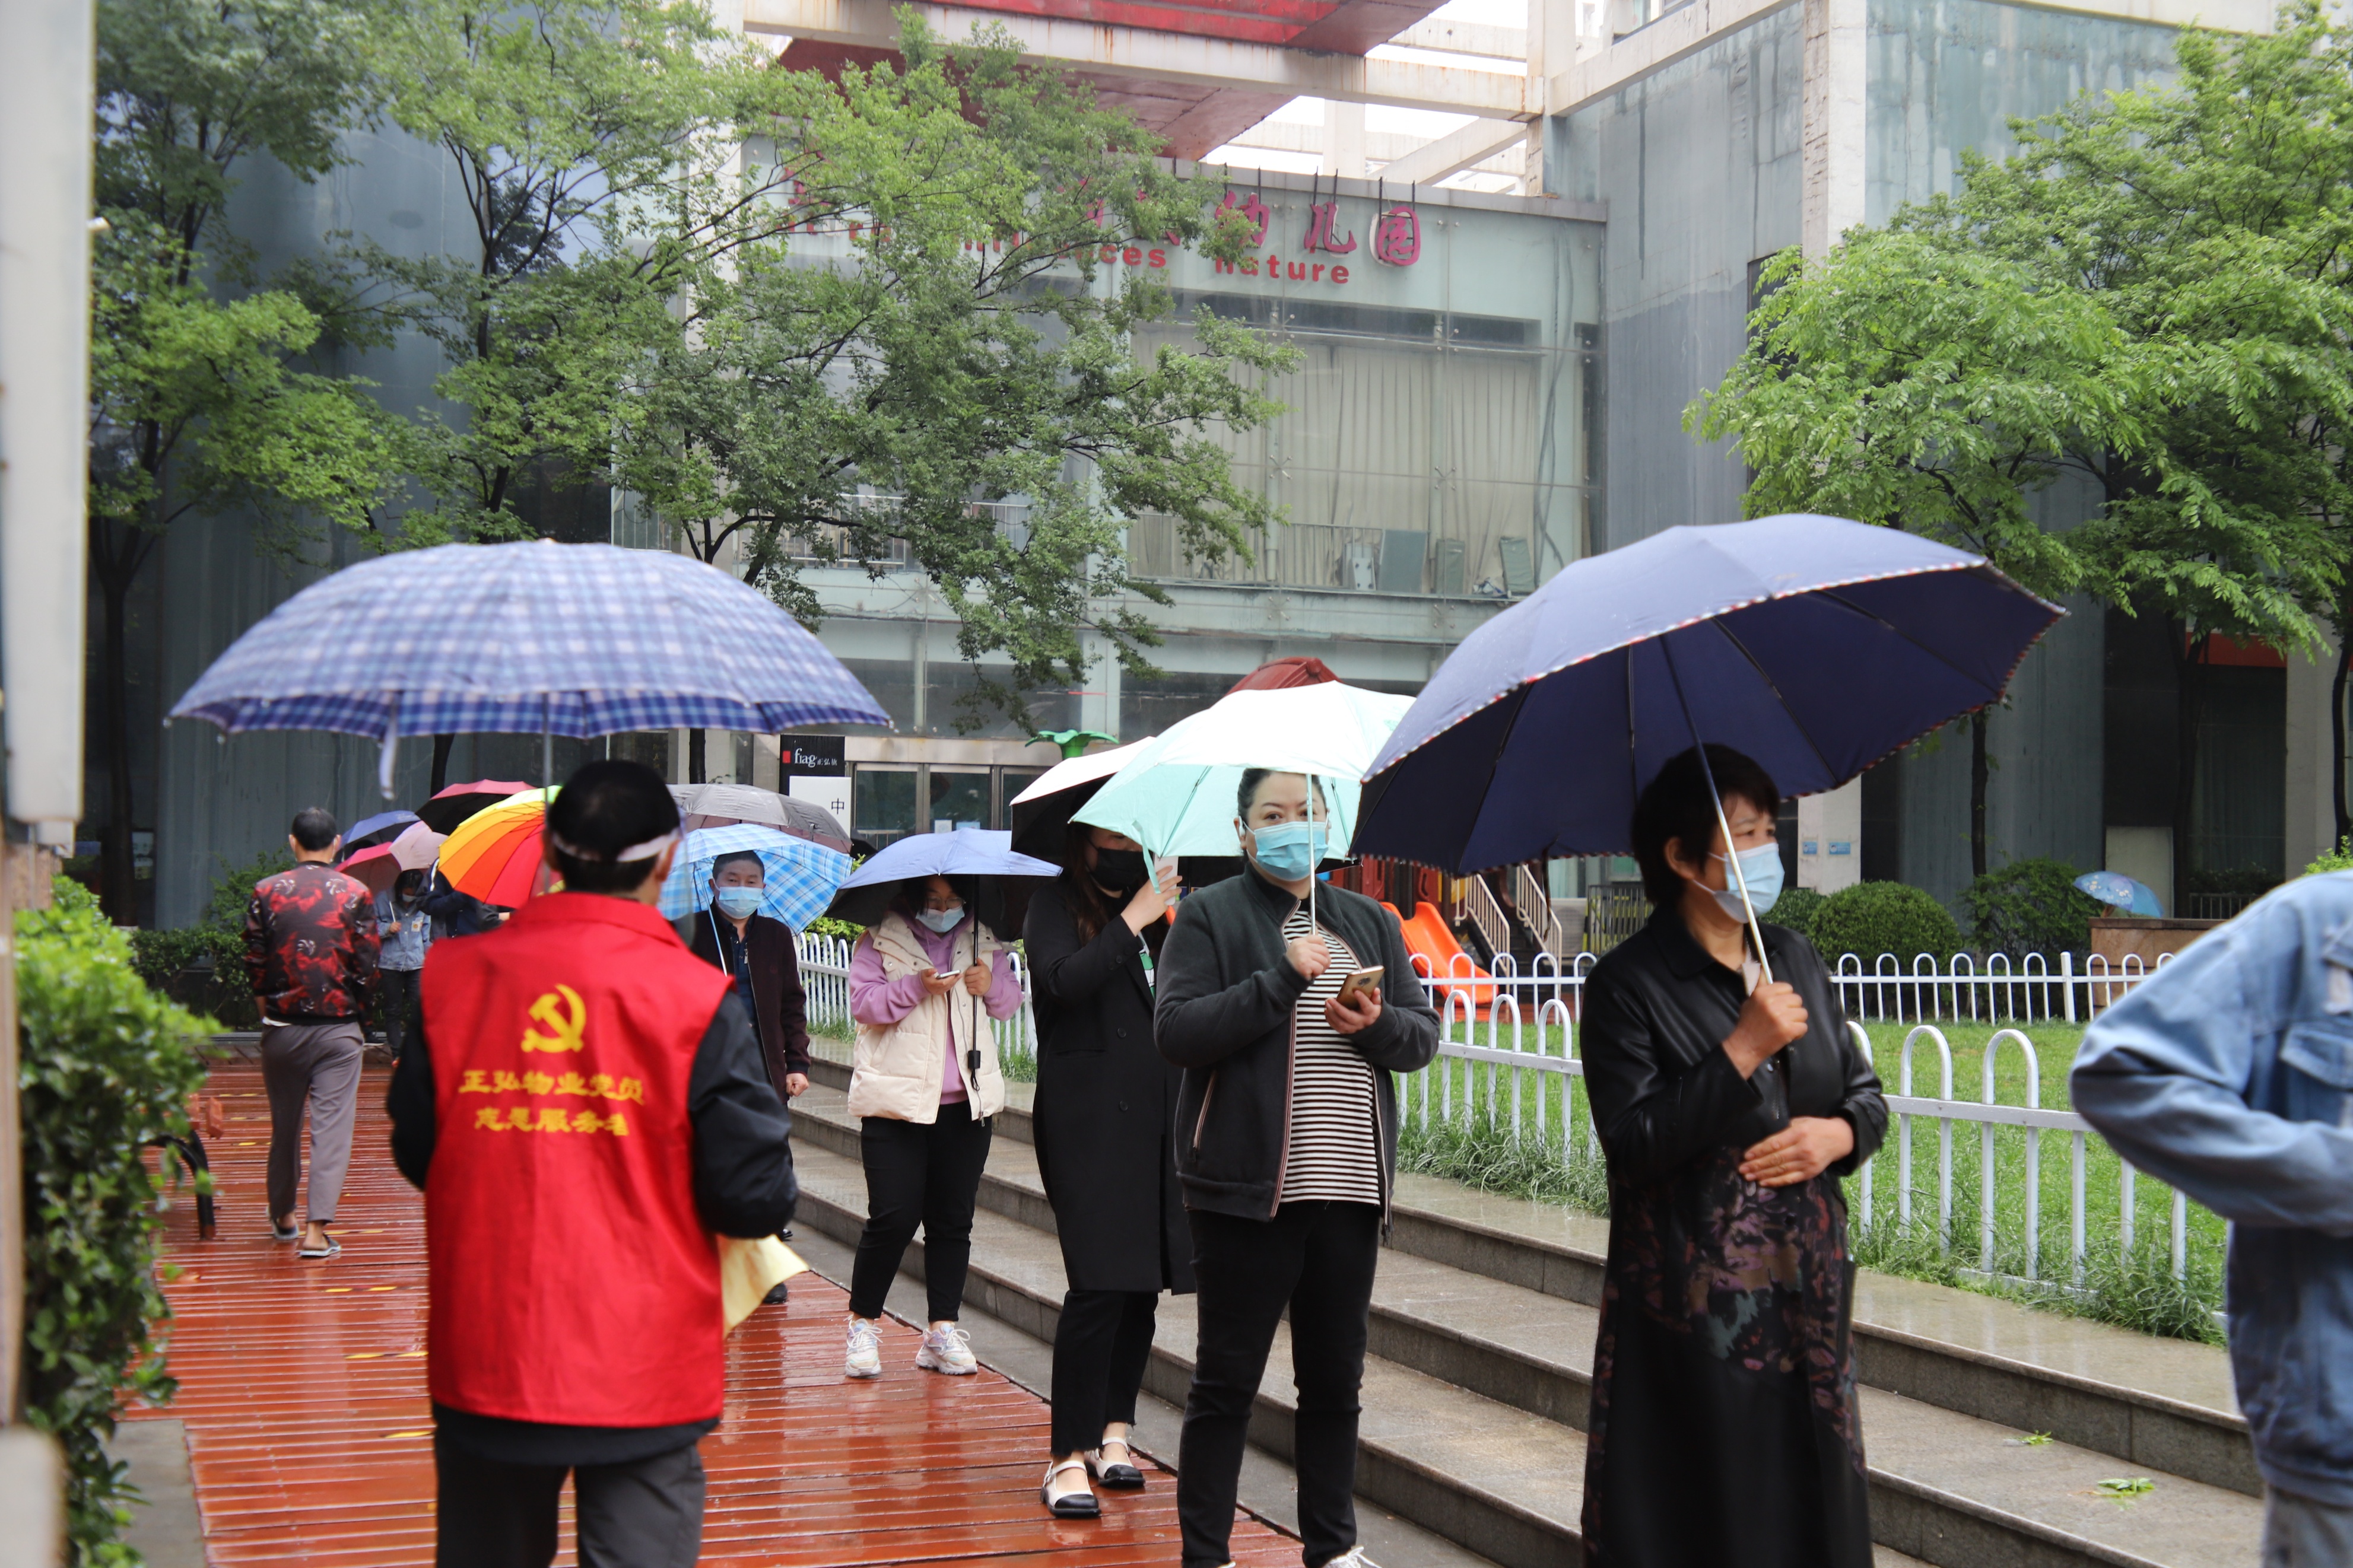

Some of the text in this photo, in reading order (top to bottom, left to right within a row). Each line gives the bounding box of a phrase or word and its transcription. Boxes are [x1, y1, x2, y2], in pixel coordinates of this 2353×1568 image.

[1215, 255, 1349, 284] nature
[831, 797, 844, 815] 中
[458, 1069, 646, 1106] 正弘物业党员
